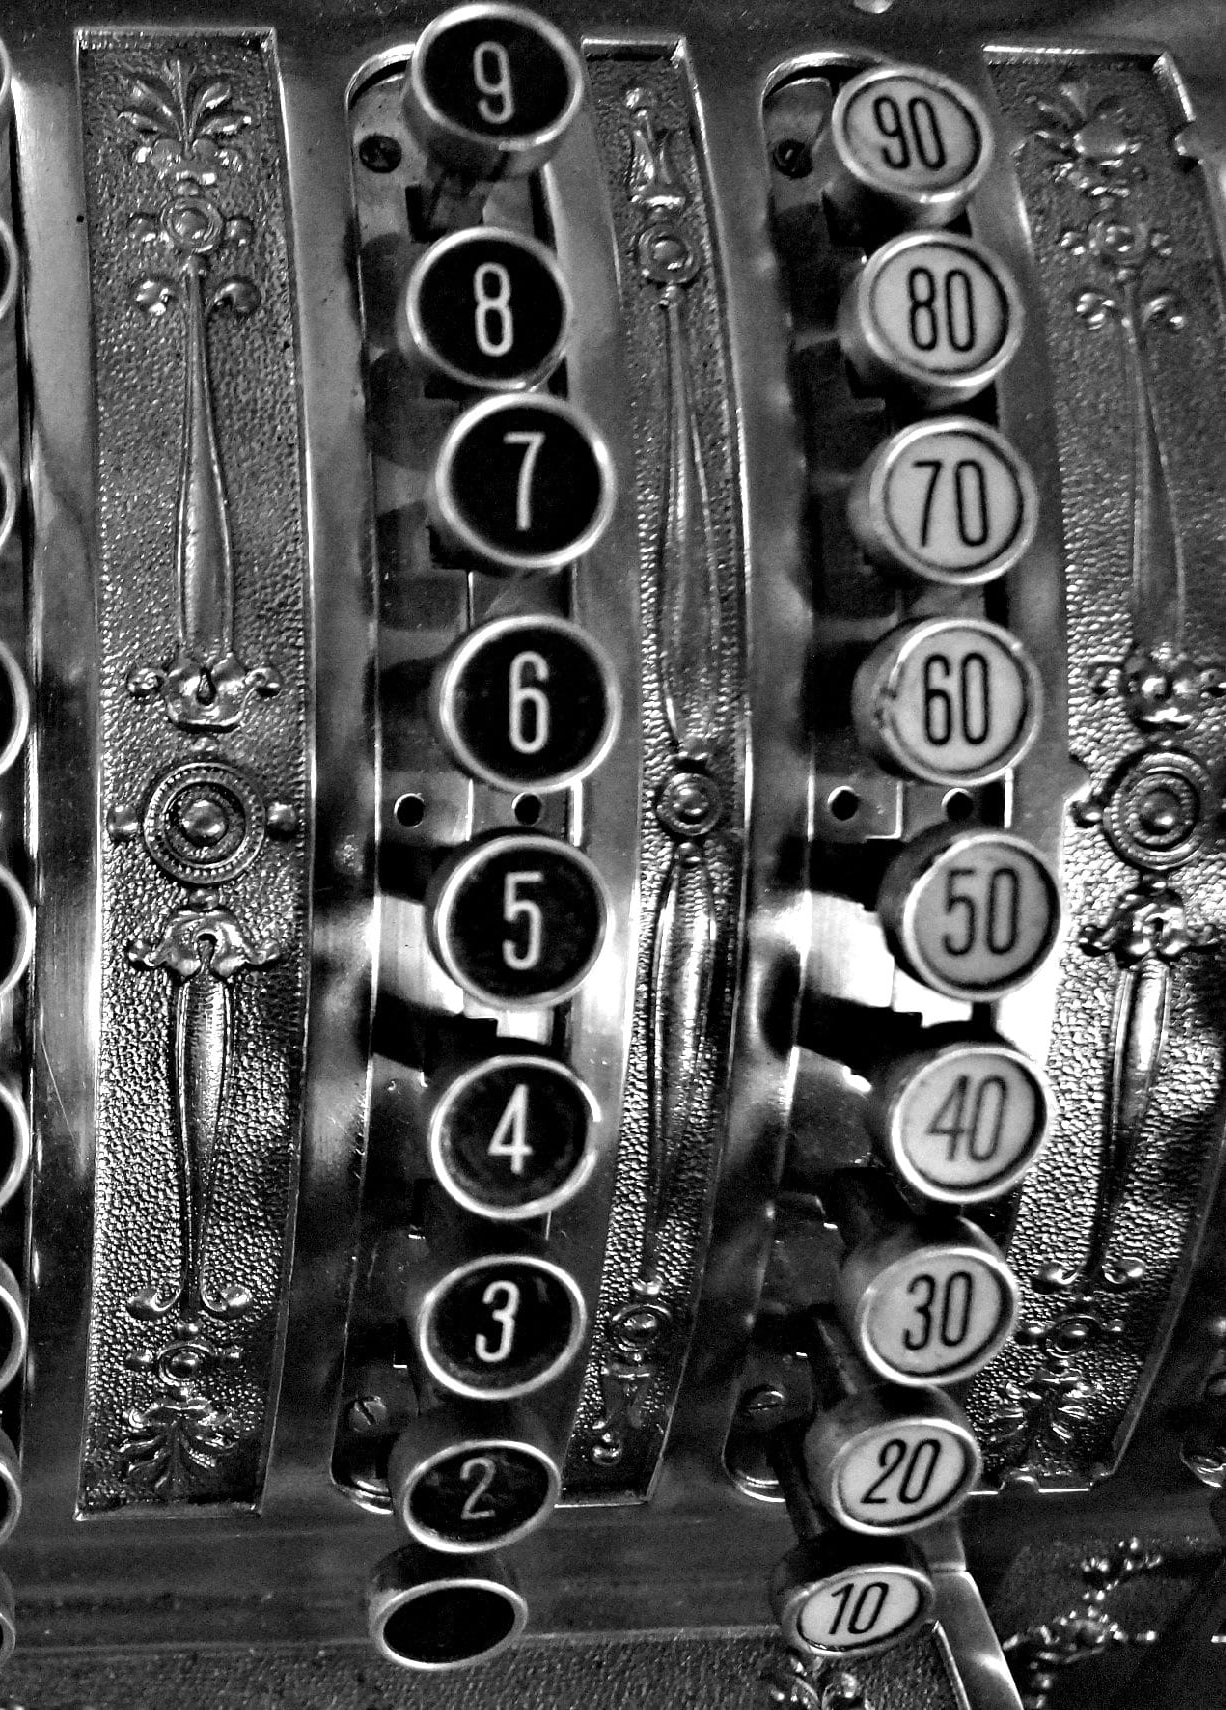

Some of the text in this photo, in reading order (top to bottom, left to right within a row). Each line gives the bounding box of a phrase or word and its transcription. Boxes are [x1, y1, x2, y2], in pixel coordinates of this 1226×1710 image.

[471, 42, 512, 125] 9
[872, 94, 947, 170] 90
[474, 262, 513, 357] 8
[907, 268, 976, 354] 80
[502, 431, 546, 531] 7
[913, 459, 989, 548] 70
[508, 650, 550, 754] 6
[922, 651, 991, 746] 60
[503, 871, 542, 971] 5
[944, 867, 1020, 957] 50
[487, 1084, 533, 1175] 4
[926, 1074, 1007, 1162] 40
[475, 1279, 520, 1363] 3
[903, 1271, 973, 1351] 30
[461, 1457, 495, 1520] 2
[863, 1439, 943, 1504] 20
[830, 1582, 890, 1634] 10
